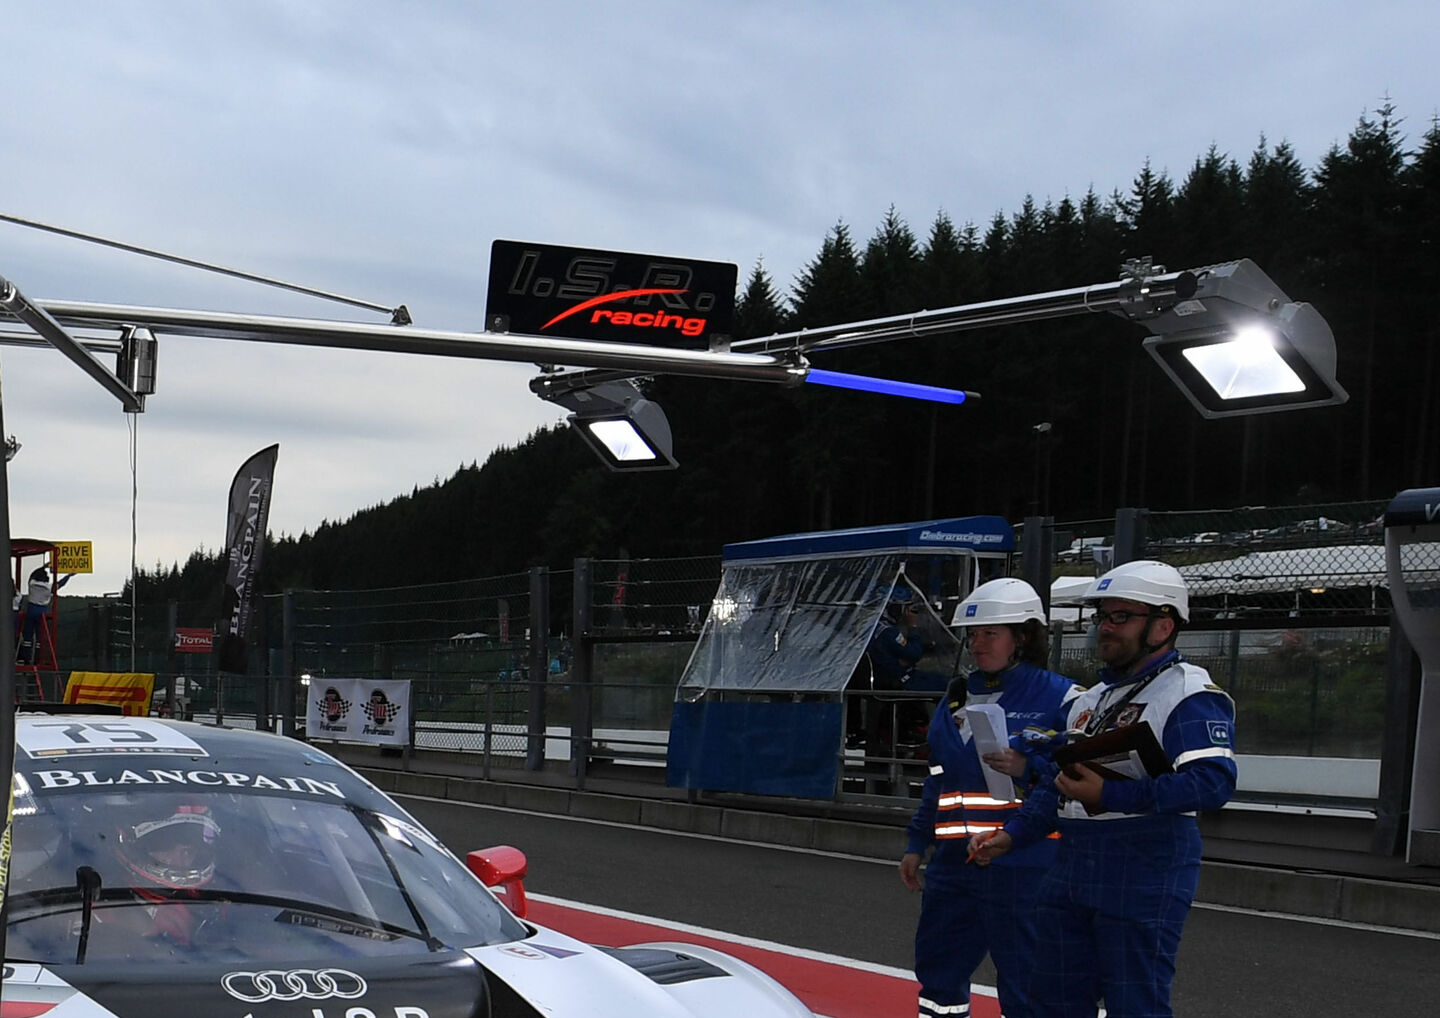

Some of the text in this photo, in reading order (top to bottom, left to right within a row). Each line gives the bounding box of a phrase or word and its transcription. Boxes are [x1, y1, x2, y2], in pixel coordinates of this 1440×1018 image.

[590, 309, 707, 337] racing
[57, 557, 89, 569] HROUGH
[229, 476, 262, 637] BLANCPAIN
[181, 636, 212, 645] TOTAL
[32, 722, 159, 744] 75
[33, 769, 346, 799] BLANCPAIN
